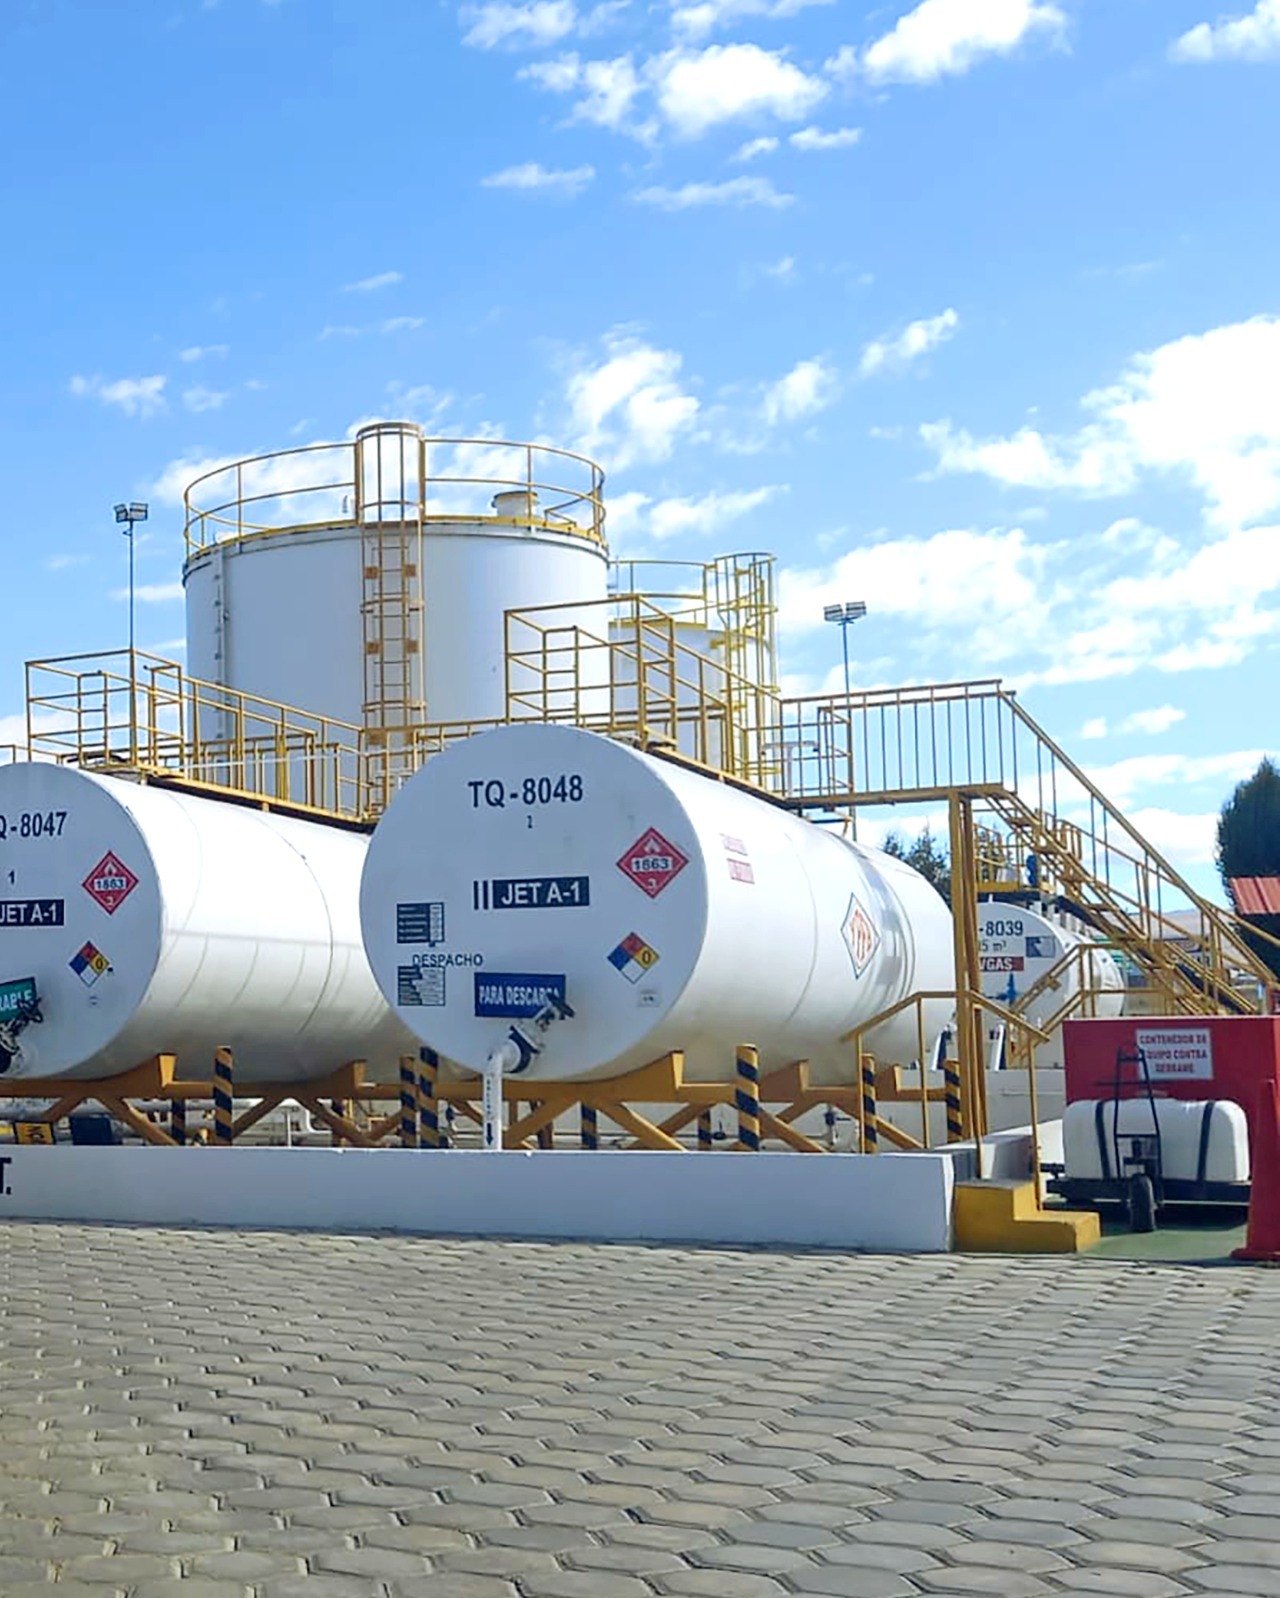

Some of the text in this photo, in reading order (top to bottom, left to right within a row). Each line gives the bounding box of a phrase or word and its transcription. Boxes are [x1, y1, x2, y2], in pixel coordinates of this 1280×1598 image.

[468, 775, 583, 808] TQ-8048
[8, 870, 15, 885] 1
[501, 881, 580, 905] JET A-1
[30, 903, 57, 922] A-1
[978, 920, 1024, 937] -8039
[412, 953, 484, 969] DESPACHO
[978, 957, 1013, 971] VGAS
[479, 985, 505, 1005] PARA
